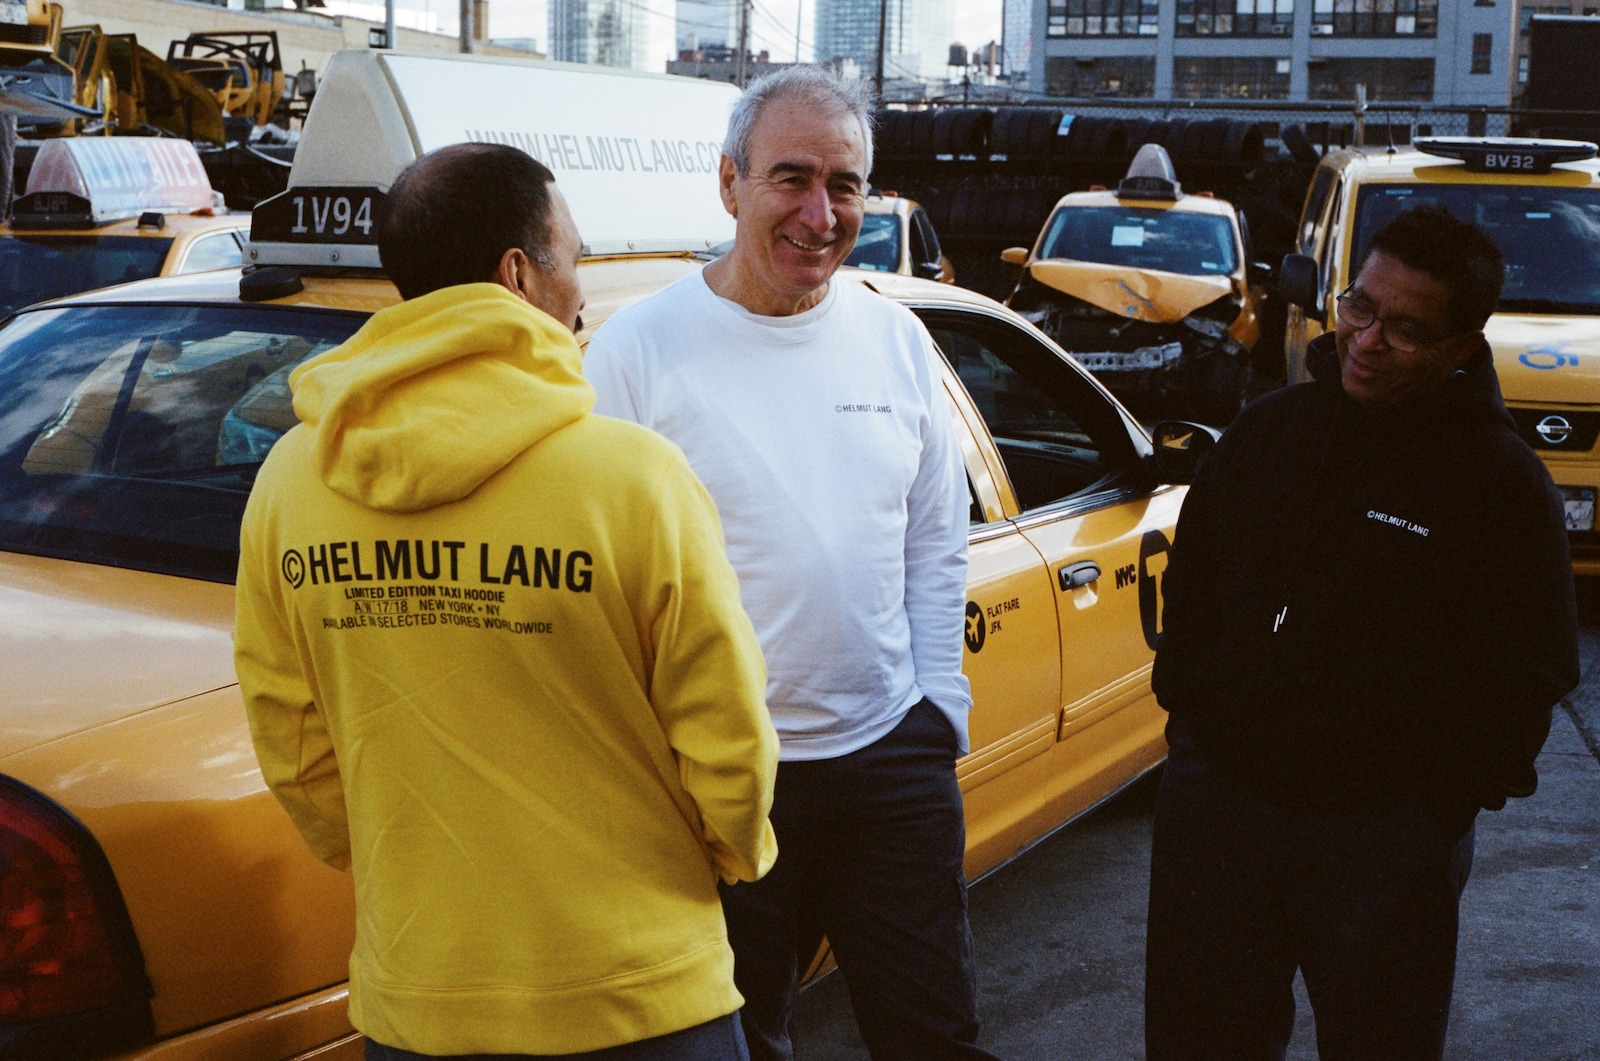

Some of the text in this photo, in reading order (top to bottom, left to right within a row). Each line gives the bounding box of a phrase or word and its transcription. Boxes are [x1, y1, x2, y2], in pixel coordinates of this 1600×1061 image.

[464, 129, 724, 174] W.HELMUTLANG.CO
[1485, 153, 1534, 169] 8V32
[291, 196, 373, 236] 1V94
[873, 405, 892, 413] LANG
[1407, 521, 1430, 537] LANG
[480, 542, 593, 593] LANG
[1115, 563, 1137, 590] NYC
[344, 585, 505, 603] LIMITED EDITION TAXI HOODIE
[376, 600, 408, 613] 17/18
[419, 600, 445, 611] NEW
[449, 600, 475, 616] YORK
[486, 603, 500, 616] NY
[986, 597, 1020, 619] FLAT FARE
[323, 614, 368, 629] ALABLE
[377, 613, 437, 628] SELECTED
[440, 612, 481, 629] STORES
[483, 617, 553, 634] WORLDWIDE
[990, 619, 1002, 635] JFK
